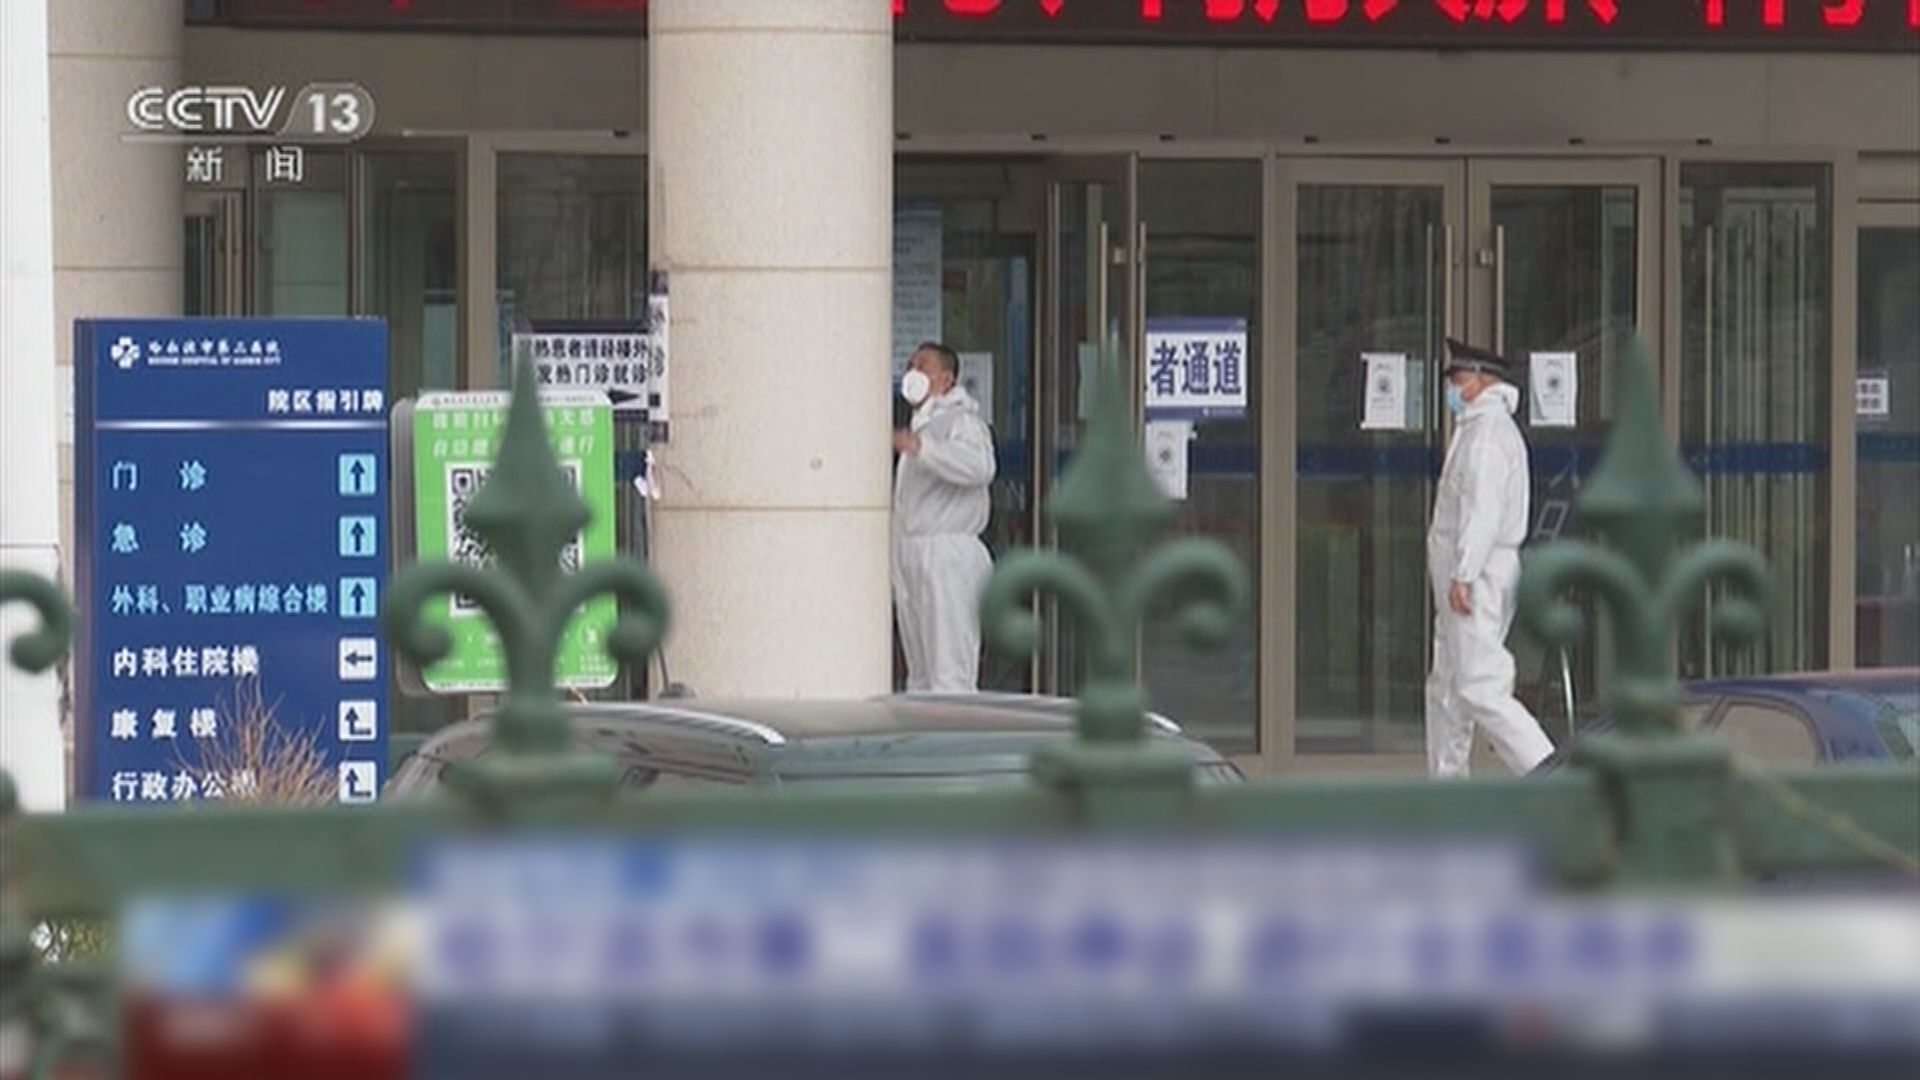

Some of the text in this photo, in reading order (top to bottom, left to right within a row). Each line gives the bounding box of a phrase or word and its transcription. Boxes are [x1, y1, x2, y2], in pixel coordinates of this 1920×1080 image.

[1144, 339, 1243, 396] 者通道
[267, 388, 384, 414] 院区指引牌
[112, 645, 260, 678] 内科住院楼
[110, 707, 217, 740] 康复楼
